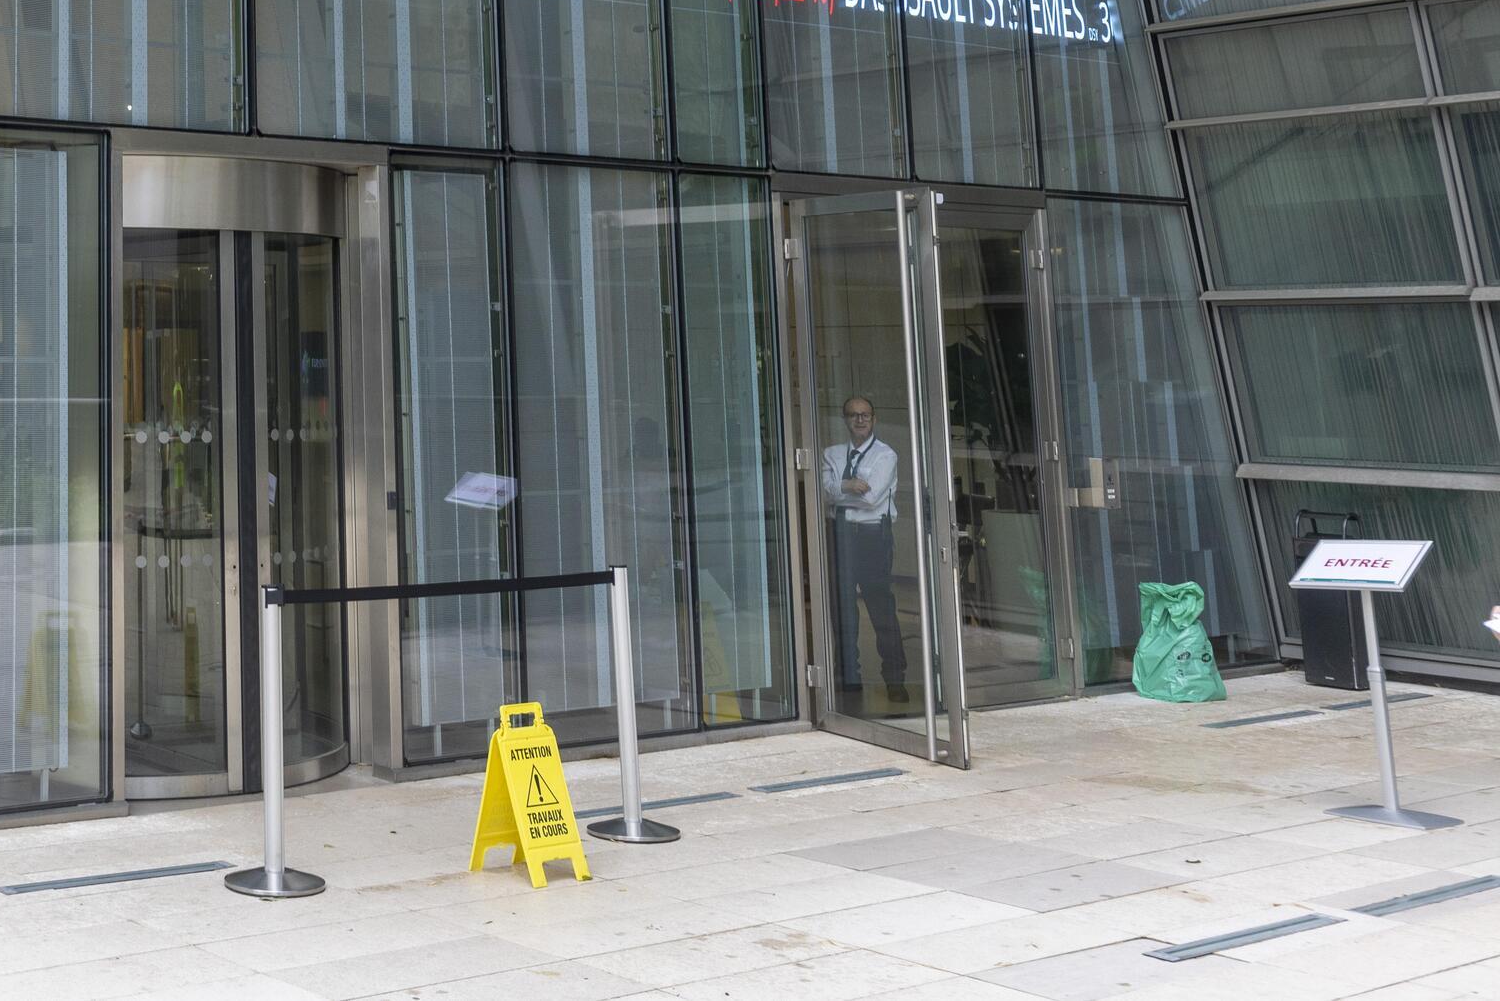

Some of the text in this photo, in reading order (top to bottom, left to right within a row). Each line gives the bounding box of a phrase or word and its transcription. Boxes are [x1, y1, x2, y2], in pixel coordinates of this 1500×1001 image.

[1323, 557, 1394, 569] ENTRÉE
[510, 745, 552, 761] ATTENTION
[527, 809, 564, 825] TRAVAUX
[529, 823, 569, 839] EN COURS
